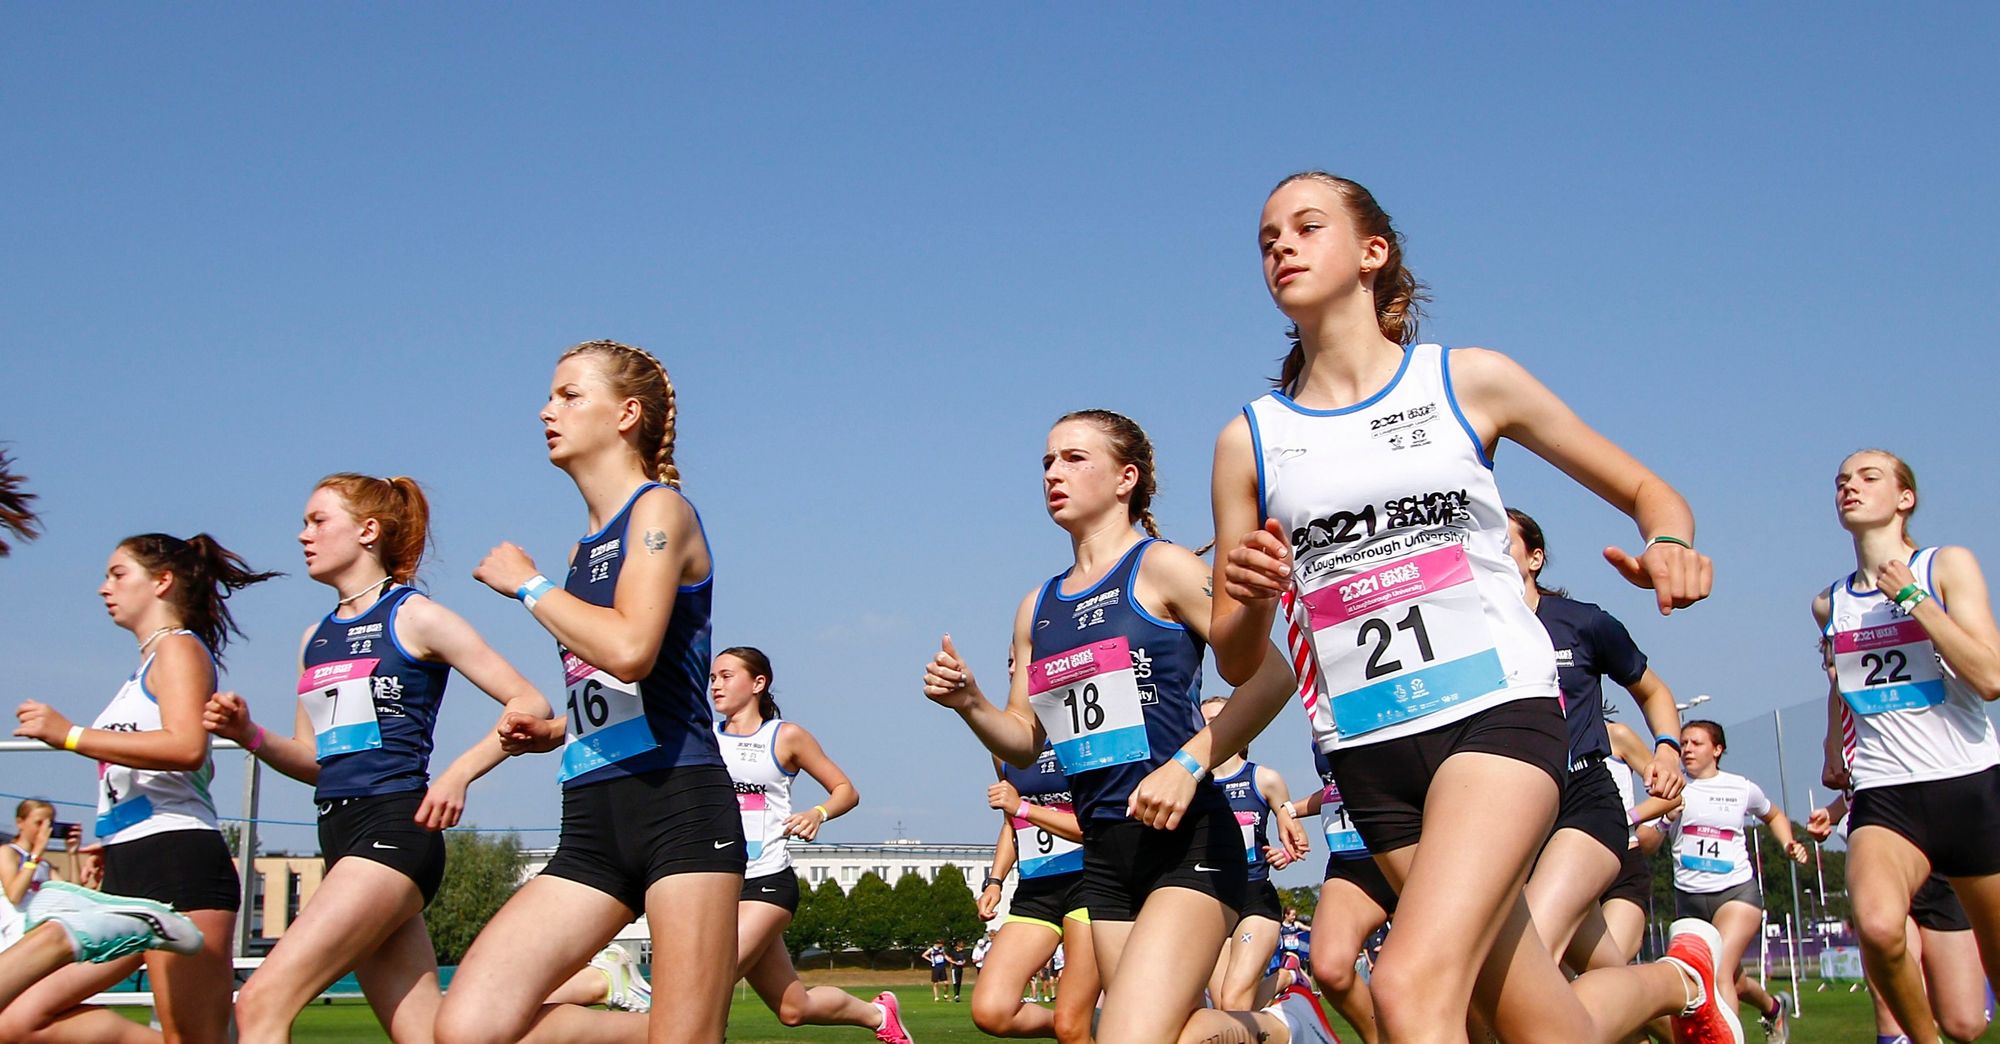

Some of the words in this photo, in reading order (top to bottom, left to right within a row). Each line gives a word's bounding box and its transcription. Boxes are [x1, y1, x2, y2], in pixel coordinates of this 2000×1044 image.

[1385, 489, 1471, 517] SCHOOL
[1386, 506, 1470, 529] GAMES
[1292, 504, 1376, 560] 2021
[1312, 540, 1401, 572] Loughborough
[1404, 530, 1465, 547] University
[1339, 575, 1380, 603] 2021
[1382, 570, 1421, 588] GAMES
[1357, 604, 1434, 680] 21
[1045, 656, 1071, 676] 2021
[1861, 649, 1911, 686] 22
[325, 688, 338, 725] 7
[567, 679, 609, 735] 16
[1063, 682, 1105, 734] 18
[1036, 828, 1054, 854] 9
[1696, 839, 1720, 858] 14
